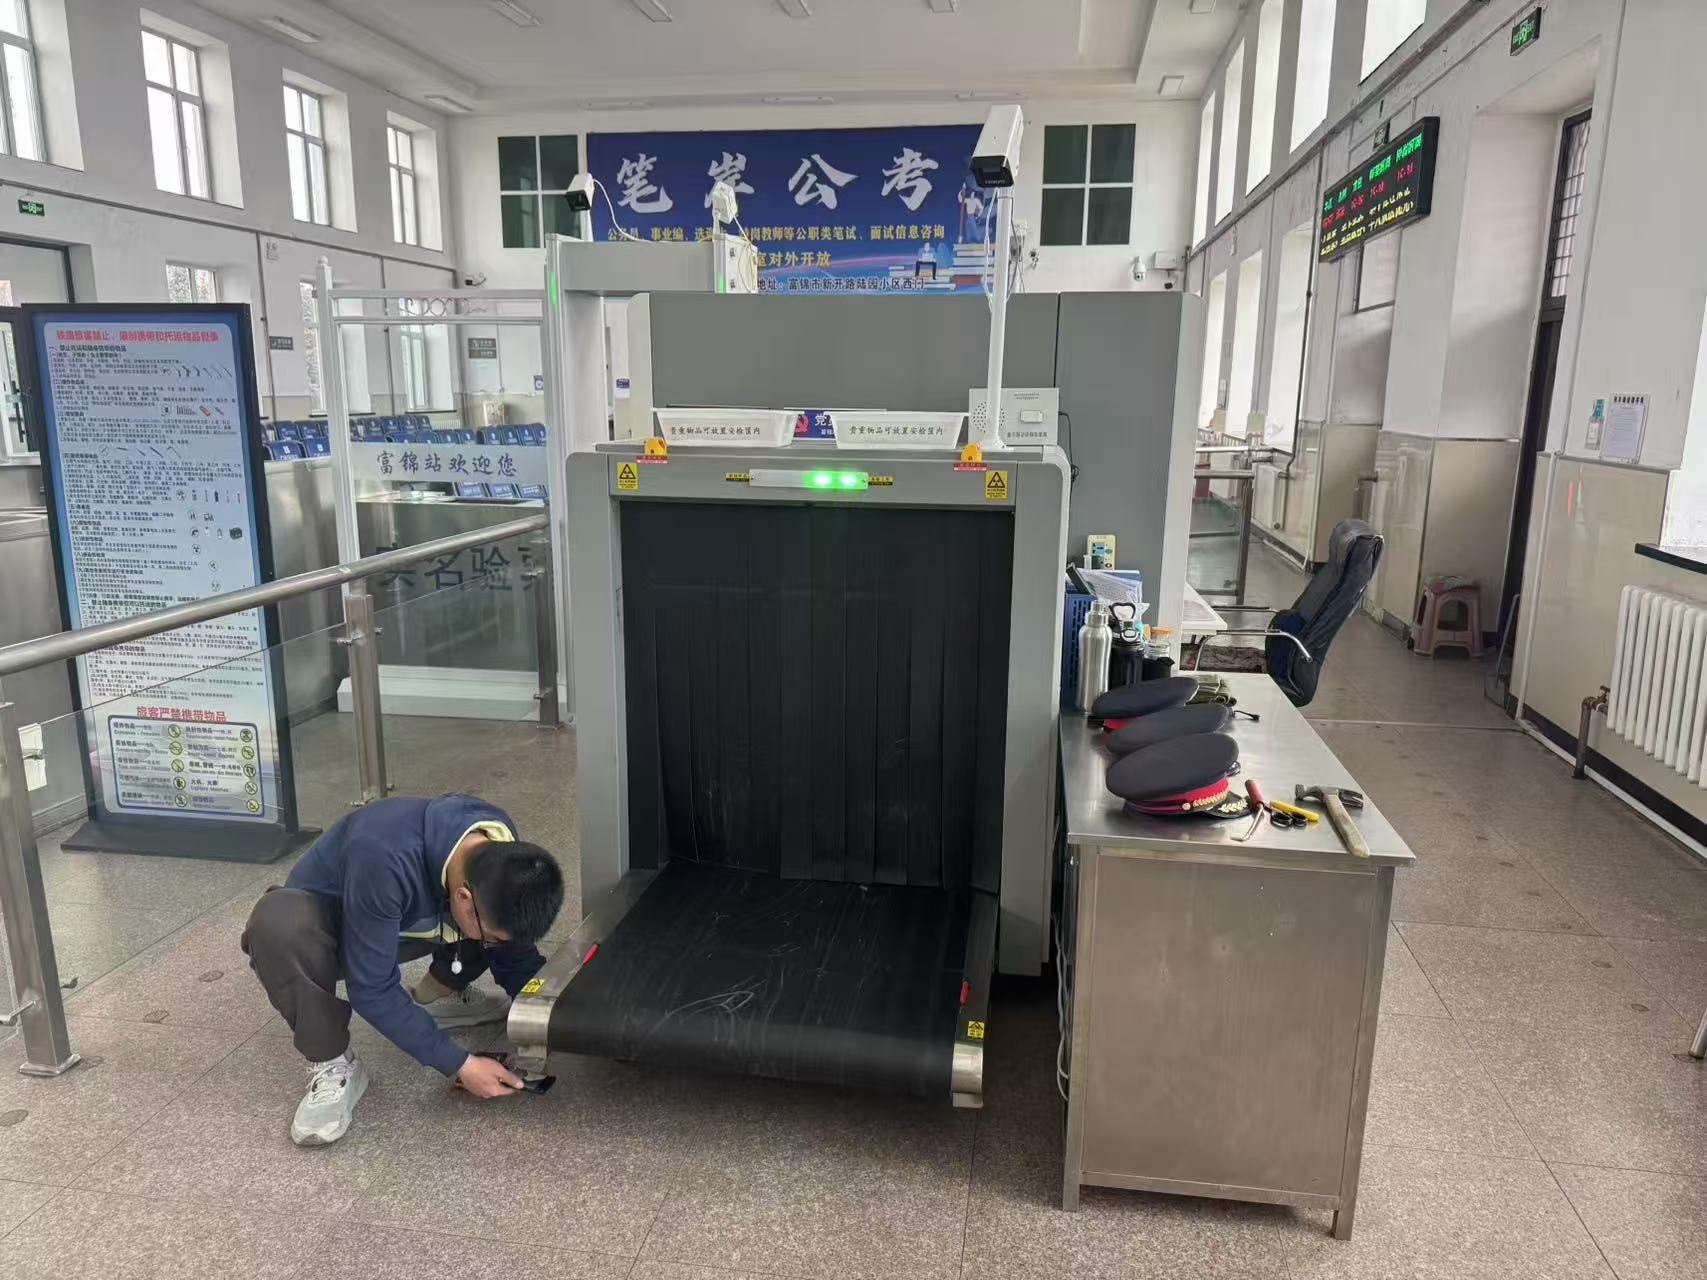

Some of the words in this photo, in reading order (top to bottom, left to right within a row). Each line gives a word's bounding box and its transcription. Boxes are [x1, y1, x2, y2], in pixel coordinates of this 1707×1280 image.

[756, 251, 831, 267] 室对外开放
[377, 450, 517, 477] 富锦站欢迎您
